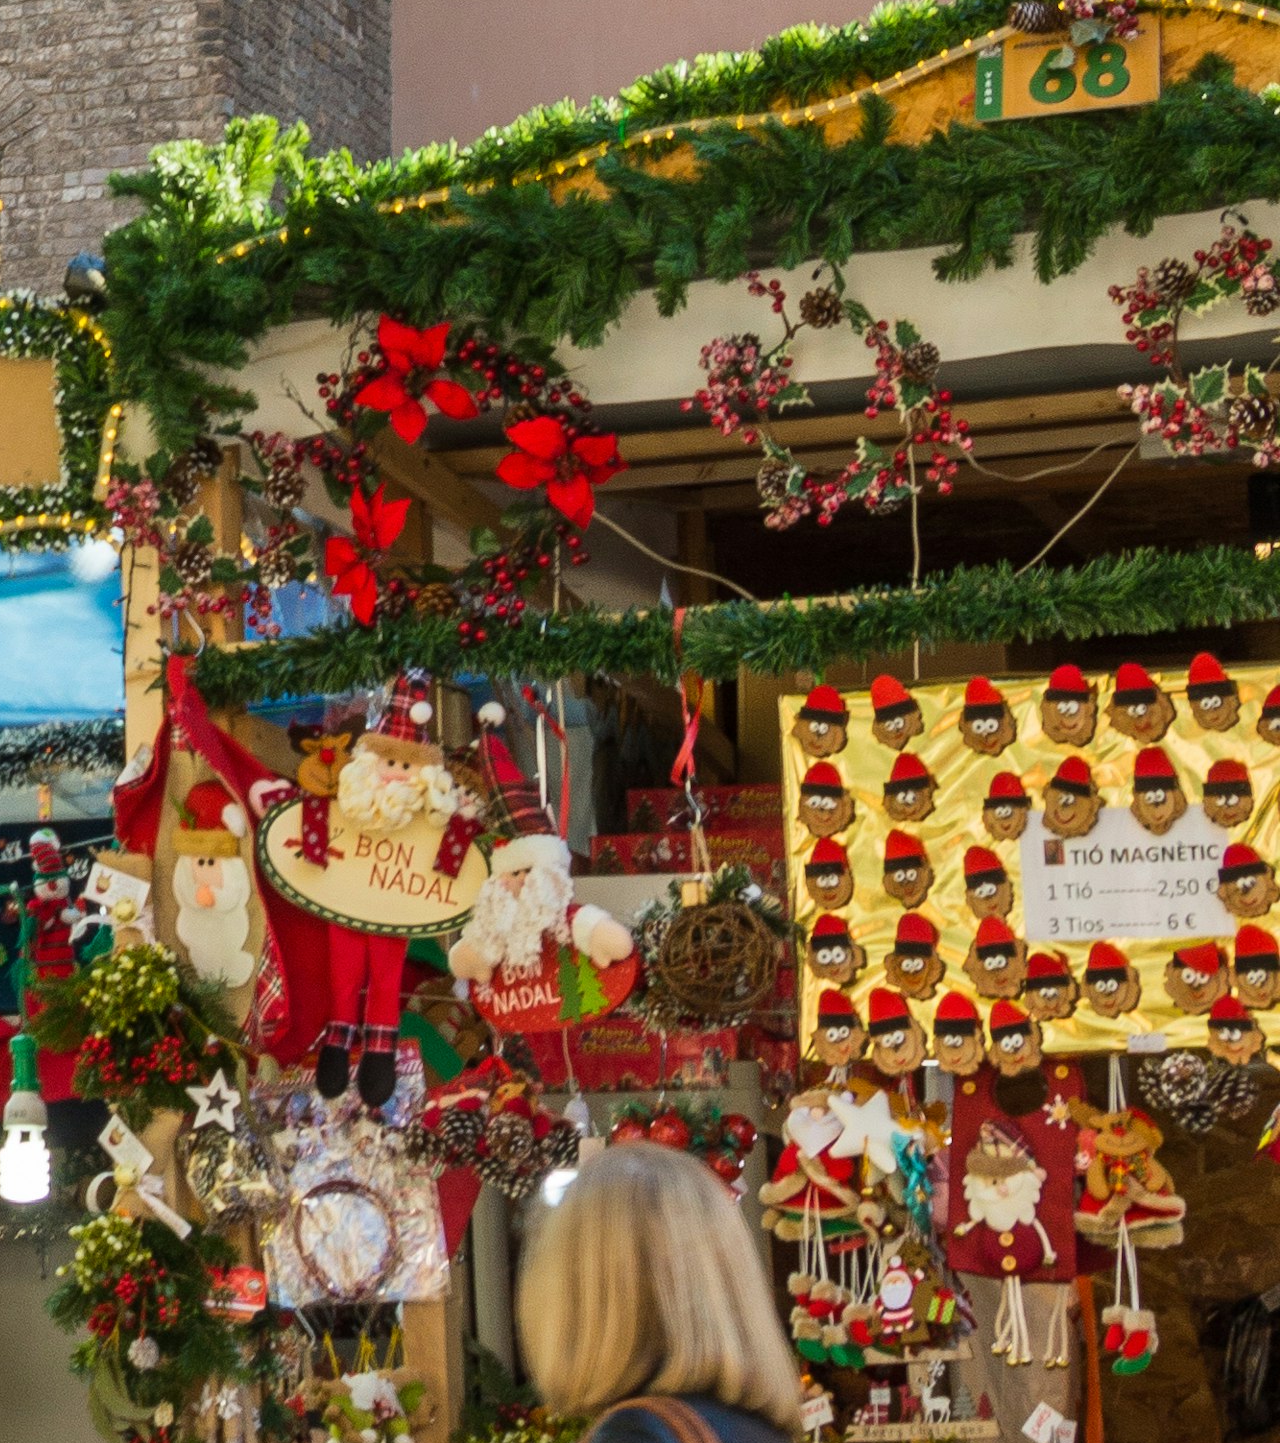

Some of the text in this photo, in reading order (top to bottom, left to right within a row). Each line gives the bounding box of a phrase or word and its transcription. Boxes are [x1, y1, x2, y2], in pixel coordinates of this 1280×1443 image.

[1028, 43, 1130, 105] 68
[354, 834, 416, 869] BON
[1070, 840, 1220, 865] TIÓ MAGNÈTIC
[368, 865, 458, 906] NADAL
[1047, 878, 1219, 901] 1 Tió 2,50 €
[1048, 913, 1198, 935] 3 Tios 6 €
[501, 962, 542, 986] BON
[492, 982, 563, 1016] NADAL
